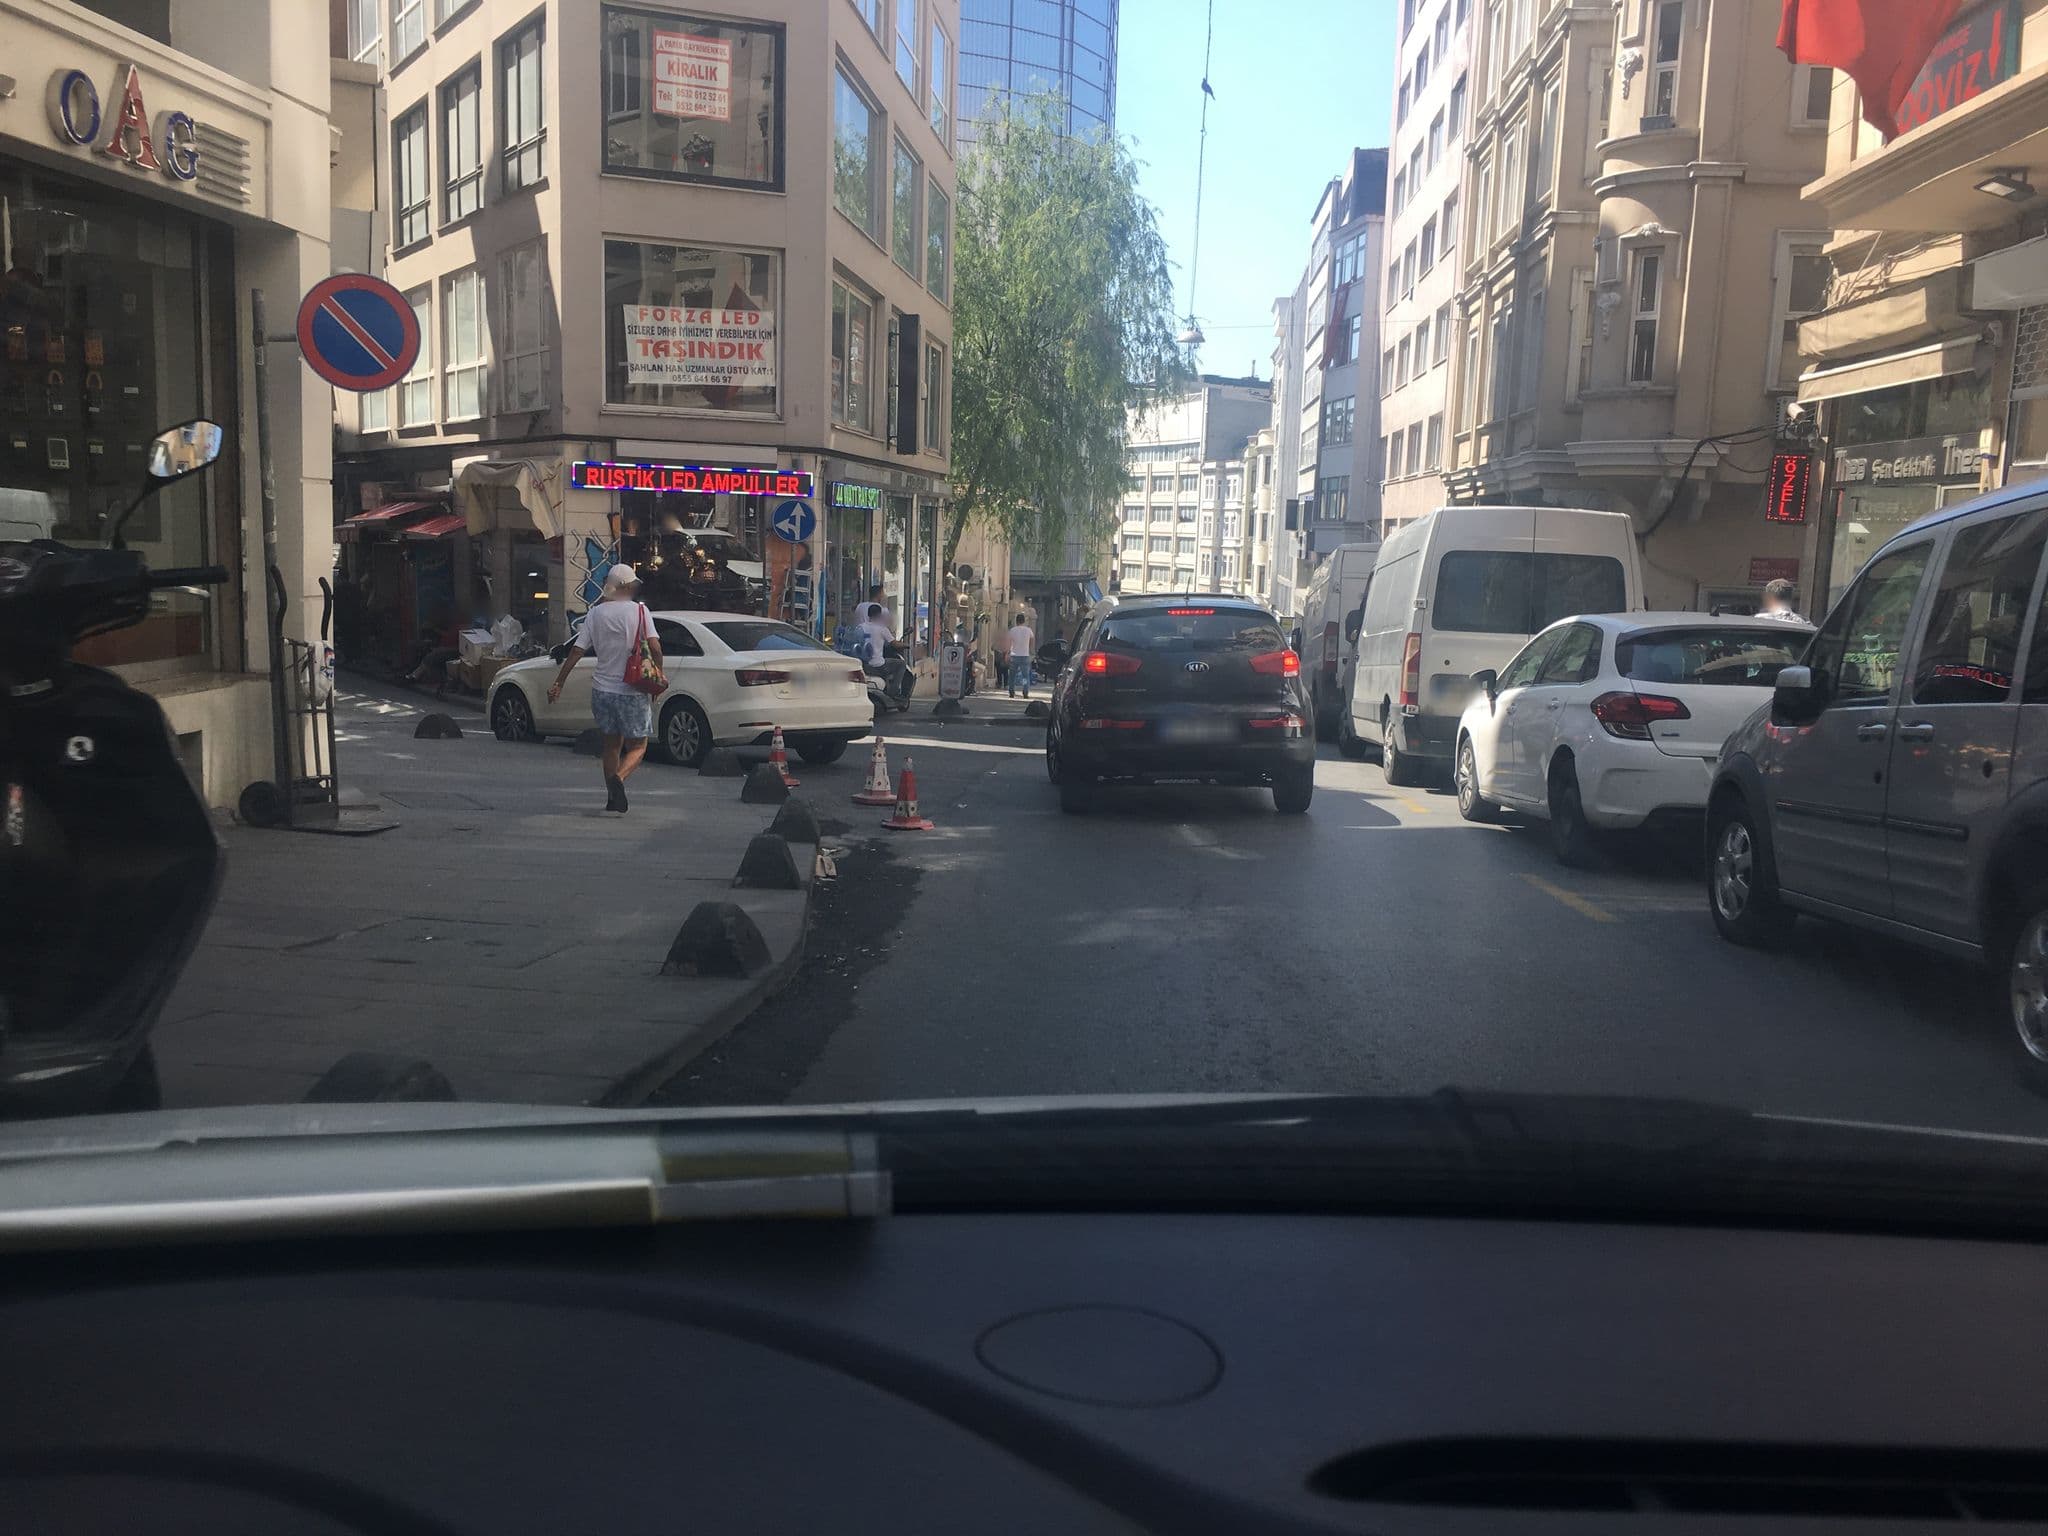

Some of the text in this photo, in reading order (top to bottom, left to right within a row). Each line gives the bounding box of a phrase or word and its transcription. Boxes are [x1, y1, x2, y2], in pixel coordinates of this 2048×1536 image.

[667, 58, 718, 81] KİRALIK
[676, 88, 693, 98] 0532
[694, 90, 707, 100] 612
[708, 92, 717, 101] 52
[676, 101, 693, 111] 0532
[46, 63, 201, 181] OAG
[638, 308, 760, 325] FORZA LED
[627, 324, 655, 336] SİZLERE
[657, 326, 677, 337] DAHA
[715, 328, 758, 339] VEREBİLMEK
[758, 329, 773, 342] İÇİN
[635, 339, 766, 362] TAŞINDIK
[629, 363, 663, 372] ŞAHLAN
[685, 365, 726, 374] UZMANLAR
[726, 365, 749, 375] ÜSTÜ
[721, 375, 733, 383] 97
[586, 467, 799, 495] RUSTİK LED AMPULLER
[1779, 458, 1797, 516] ÖZEL
[1187, 662, 1207, 673] KIA
